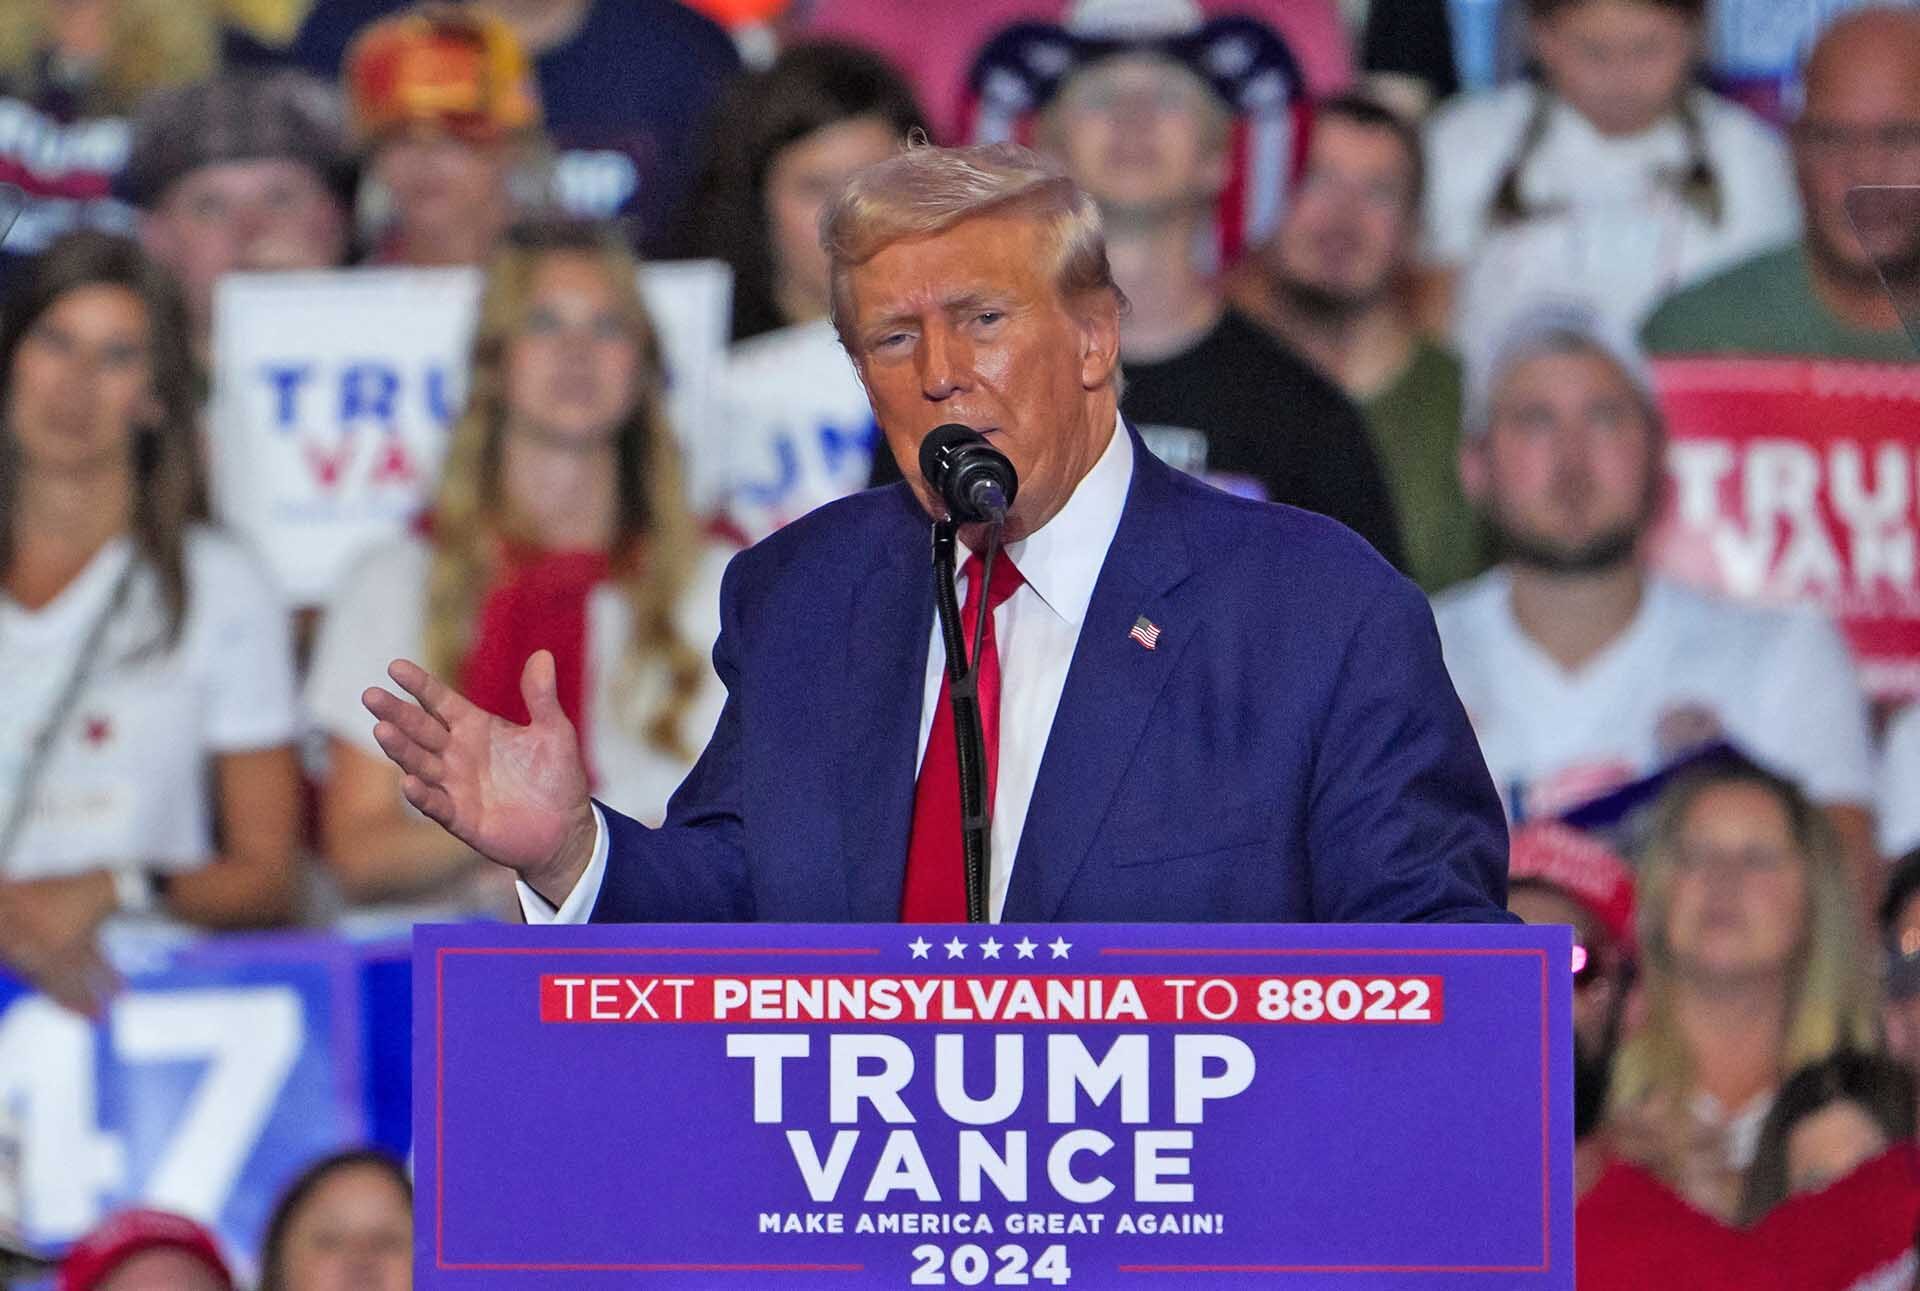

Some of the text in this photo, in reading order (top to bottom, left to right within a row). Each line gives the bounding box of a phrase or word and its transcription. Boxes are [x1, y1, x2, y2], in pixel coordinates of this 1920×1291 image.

[1668, 438, 1920, 524] TRU
[554, 979, 1431, 1021] TEXT PENNSYLVANIA TO 88022
[0, 988, 302, 1242] 47
[726, 1033, 1256, 1125] TRUMP
[785, 1129, 1194, 1203] VANCE
[759, 1213, 1224, 1234] MAKE AMERICA GREAT AGAIN!
[911, 1244, 1072, 1286] 2024
